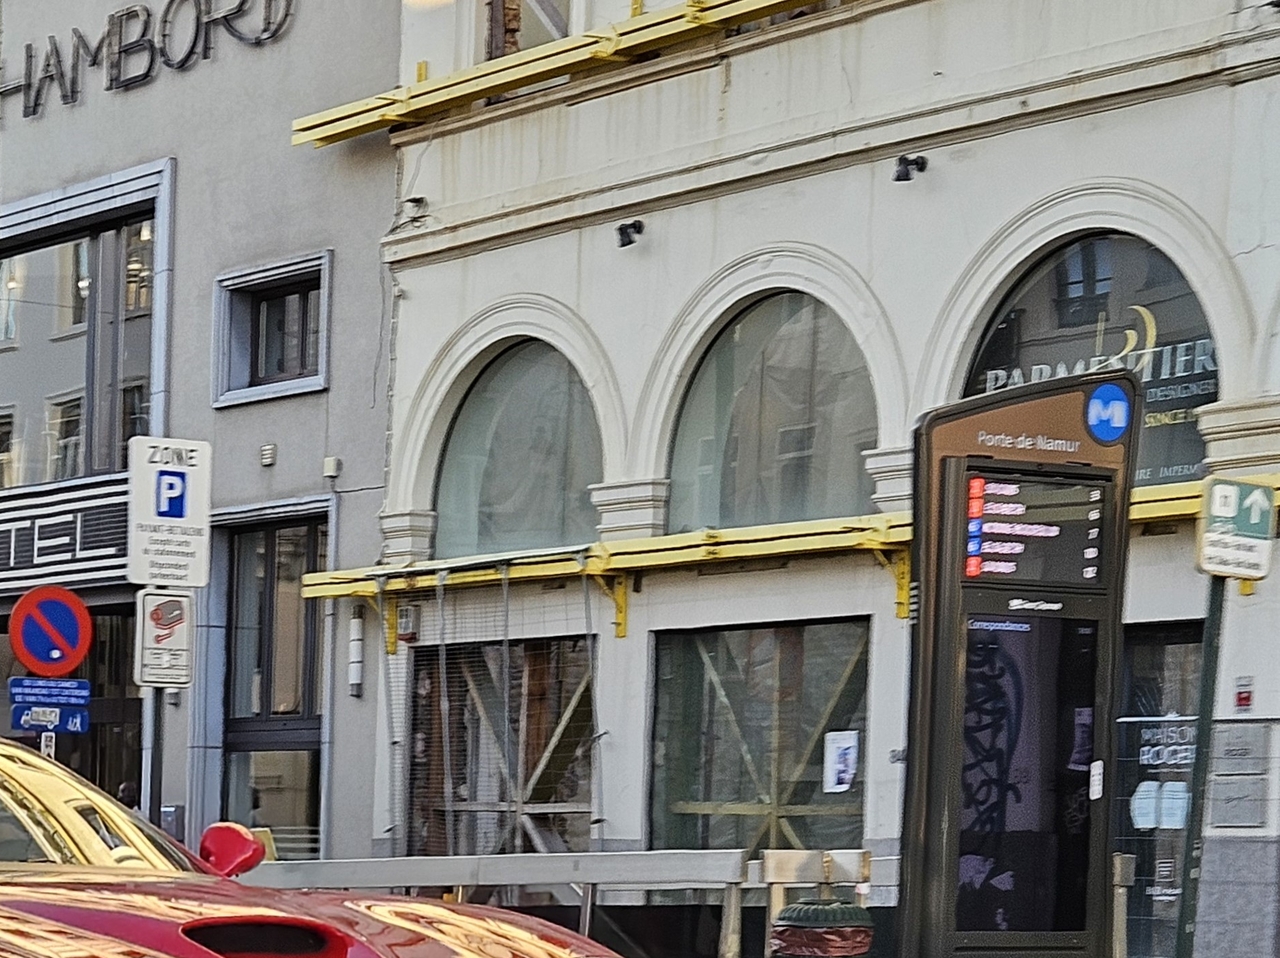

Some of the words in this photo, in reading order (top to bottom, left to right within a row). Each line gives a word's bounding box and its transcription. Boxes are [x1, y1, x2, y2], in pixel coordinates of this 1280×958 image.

[978, 430, 1014, 448] Porte
[1015, 433, 1035, 449] de
[1037, 435, 1081, 452] Namur
[147, 445, 199, 467] ZONE
